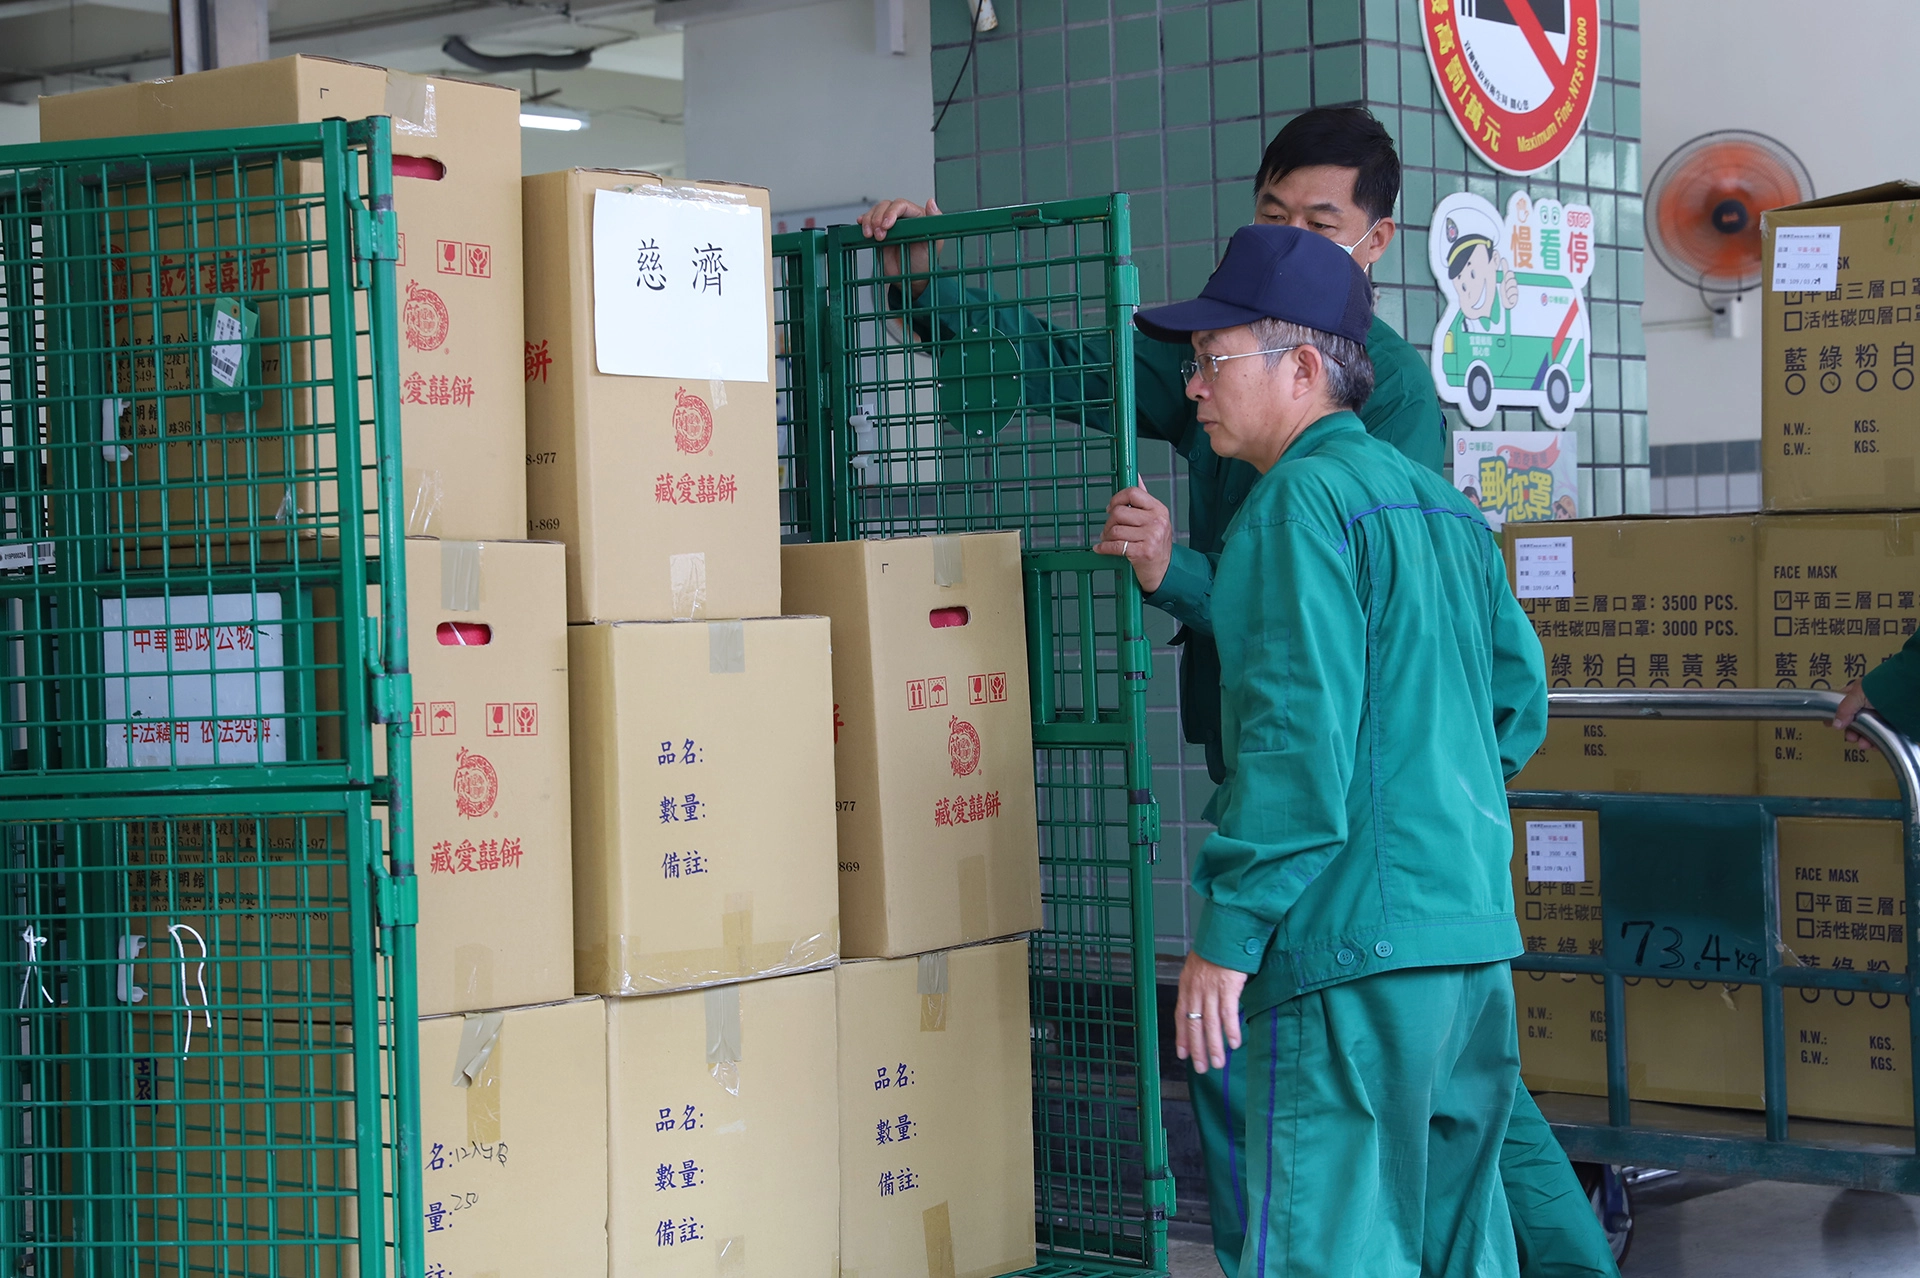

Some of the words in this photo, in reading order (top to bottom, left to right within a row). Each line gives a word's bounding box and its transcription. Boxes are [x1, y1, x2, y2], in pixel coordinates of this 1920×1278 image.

[1517, 122, 1558, 152] Maximum
[1553, 97, 1576, 128] Fine:
[1567, 211, 1591, 228] STOP
[1837, 256, 1850, 270] SK
[1784, 347, 1807, 372] 藍
[1819, 345, 1842, 370] 綠
[1855, 343, 1878, 368] 粉
[1893, 341, 1914, 367] 白
[400, 371, 475, 407] 愛囍餅
[1783, 422, 1811, 436] N.W.:
[1854, 419, 1880, 433] KGS.
[1783, 442, 1811, 456] G.W.:
[1854, 439, 1880, 454] KGS.
[655, 472, 738, 505] 藏愛囍餅
[1774, 565, 1801, 579] FACE
[1807, 565, 1838, 579] MASK
[1662, 594, 1697, 611] 3500
[1704, 594, 1738, 611] PCS.
[1662, 620, 1698, 637] 3000
[1704, 620, 1738, 637] PCS.
[1551, 653, 1572, 677] 綠
[1583, 653, 1604, 677] 粉
[1617, 653, 1636, 678] 白
[1649, 653, 1670, 677] 黑
[1682, 653, 1703, 677] 黃
[1715, 653, 1738, 677] 紫
[1775, 652, 1798, 677] 藍
[1809, 652, 1832, 678] 綠
[1844, 653, 1867, 678] 粉
[1583, 724, 1607, 739] KGS.
[1775, 727, 1802, 741] N.W.:
[657, 738, 704, 766] 品名:
[1583, 743, 1608, 758] KGS.
[1775, 747, 1802, 761] G.W.:
[1843, 748, 1870, 764] KGS.
[658, 793, 706, 825] 數量:
[934, 790, 1002, 828] 藏愛囍餅
[430, 837, 523, 875] 藏愛囍餅
[661, 850, 708, 879] 備註:
[1795, 866, 1822, 881] FACE
[1828, 868, 1859, 883] MASK
[1527, 1006, 1553, 1020] N.W.:
[1528, 1025, 1553, 1039] G.W.:
[1800, 1029, 1828, 1045] N.W.:
[1869, 1036, 1895, 1051] KGS.
[1801, 1049, 1829, 1065] G.W.:
[1870, 1056, 1896, 1072] KGS.
[874, 1062, 914, 1091] 品名:
[655, 1104, 704, 1133] 品名:
[876, 1114, 917, 1146] 數量:
[654, 1159, 704, 1192] 數量:
[878, 1167, 919, 1197] 備註:
[655, 1216, 704, 1247] 備註:
